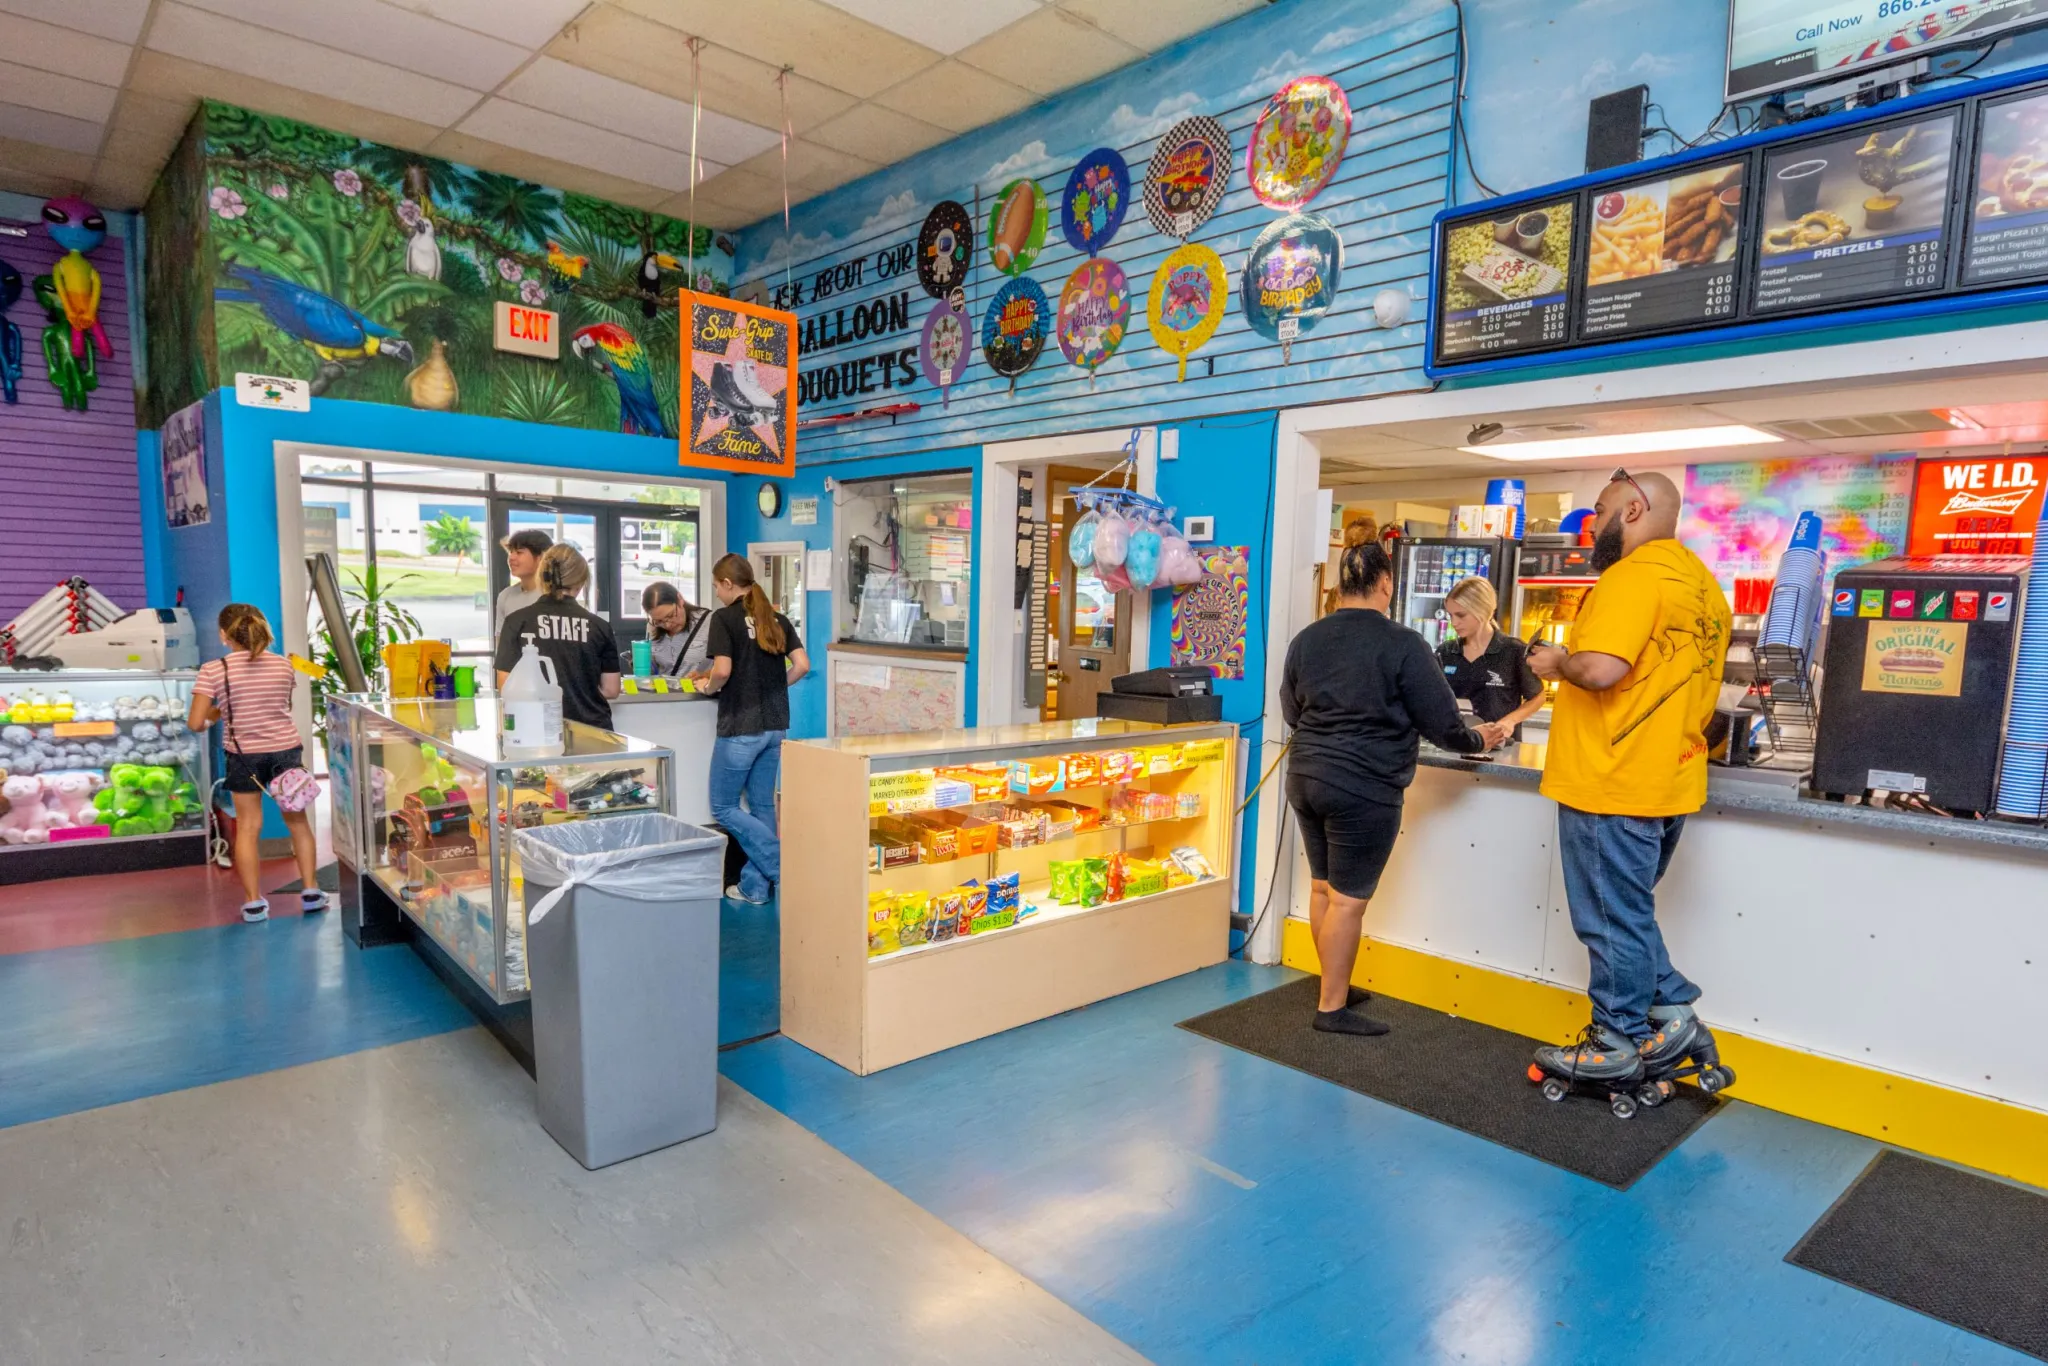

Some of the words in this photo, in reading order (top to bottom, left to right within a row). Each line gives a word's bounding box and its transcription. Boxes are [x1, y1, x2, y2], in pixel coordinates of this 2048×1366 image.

[1795, 22, 1824, 42] Call
[1828, 14, 1863, 33] Now
[1878, 0, 1942, 18] 866.2
[1171, 143, 1205, 162] HAPPY
[1974, 233, 2001, 243] Large
[2003, 228, 2029, 238] Pizza
[1813, 239, 1884, 260] PRETZELS
[1972, 245, 1995, 254] Slice
[2008, 237, 2045, 249] Topping)
[1971, 251, 2019, 266] Additional
[774, 281, 804, 312] ASK
[811, 256, 868, 302] ABOUT
[877, 243, 914, 279] OUR
[1264, 267, 1316, 291] HAPPY
[1761, 266, 1787, 277] Pretzel
[1759, 277, 1787, 288] Pretzel
[1787, 271, 1823, 283] w/Cheese
[1587, 295, 1613, 306] Chicken
[1614, 291, 1642, 302] Nuggets
[1758, 286, 1792, 298] Popcorn
[1006, 298, 1028, 317] HAPPY
[1757, 298, 1777, 308] Bowl
[1778, 296, 1787, 305] of
[1787, 292, 1821, 304] Popcorn
[1477, 299, 1534, 317] BEVERAGES
[1587, 305, 1611, 315] Cheese
[1611, 302, 1632, 311] Sticks
[509, 307, 552, 344] EXIT
[1280, 321, 1290, 329] OUT
[1290, 319, 1297, 327] OF
[1504, 320, 1522, 329] Coffee
[1586, 315, 1608, 324] French
[1609, 312, 1626, 321] Fries
[701, 314, 775, 346] Sure-Grip
[1280, 330, 1296, 338] STOCK
[1586, 325, 1603, 333] Extra
[1603, 320, 1628, 331] Cheese
[746, 358, 765, 370] SKATE
[797, 346, 918, 407] OUQUETS
[717, 430, 761, 455] Fame
[1851, 470, 1874, 479] Pizza
[1882, 468, 1908, 479] $3.50
[1943, 464, 1987, 490] WE
[1992, 461, 2039, 489] I.D.
[1880, 492, 1905, 502] $3.50
[1879, 501, 1904, 510] $4.00
[1877, 510, 1903, 519] $4.00
[1877, 519, 1901, 528] $4.00
[1205, 579, 1223, 588] FOR
[1224, 587, 1239, 611] THIS
[537, 614, 590, 643] STAFF
[1222, 613, 1239, 649] CRAZY
[1892, 625, 1911, 634] THIS
[1926, 626, 1942, 635] THE
[1875, 634, 1956, 656] ORIGINAL
[1878, 672, 1943, 687] Nathan's
[878, 776, 897, 787] CANDY
[874, 790, 896, 800] MARKED
[896, 787, 926, 798] OTHERWISE
[972, 917, 991, 932] Chips
[992, 912, 1013, 926] $1.50
